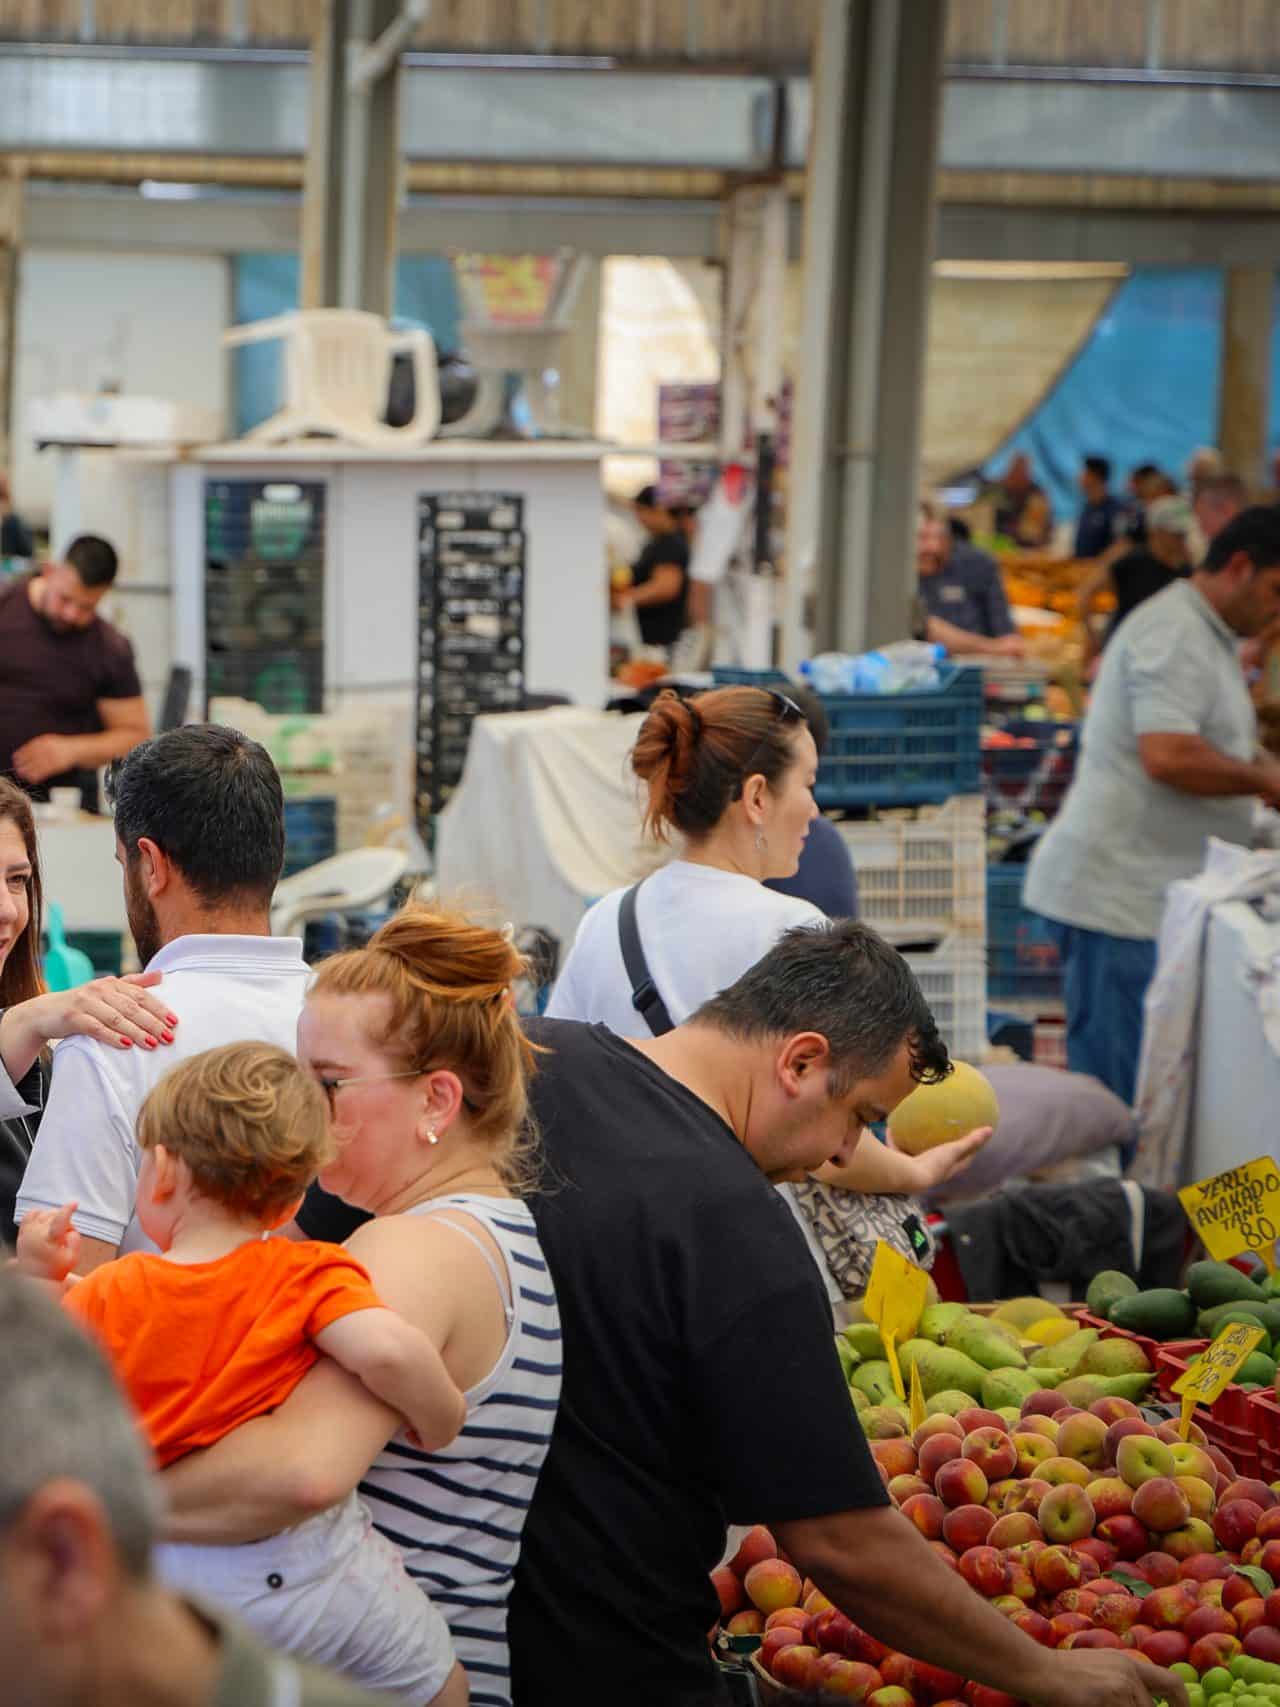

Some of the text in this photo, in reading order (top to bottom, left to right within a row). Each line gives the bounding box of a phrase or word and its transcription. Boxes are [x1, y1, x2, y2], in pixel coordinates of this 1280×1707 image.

[1197, 1173, 1280, 1228] AVAKADO
[1221, 1200, 1264, 1232] TANE
[1240, 1216, 1276, 1248] 80
